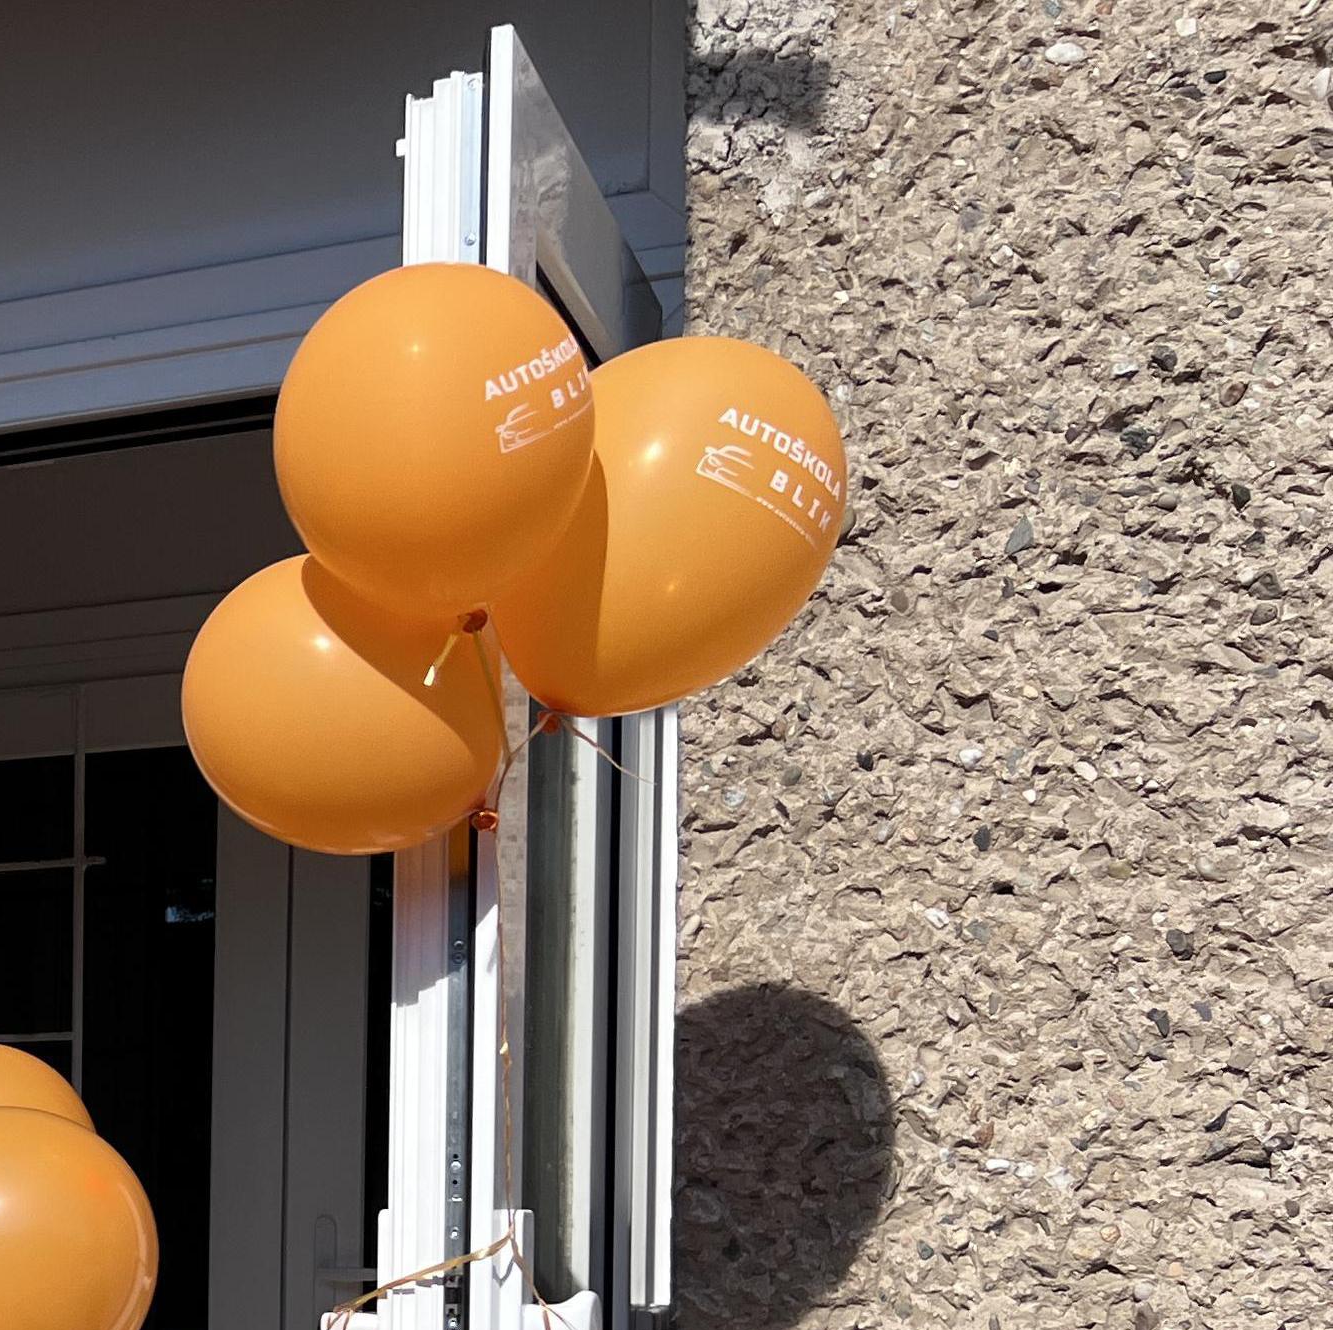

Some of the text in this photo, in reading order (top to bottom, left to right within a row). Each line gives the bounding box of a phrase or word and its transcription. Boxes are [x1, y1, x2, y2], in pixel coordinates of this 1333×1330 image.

[484, 332, 579, 401] AUTOŠKOL
[717, 407, 841, 503] AUTOŠKOLA
[769, 469, 831, 533] BLIK
